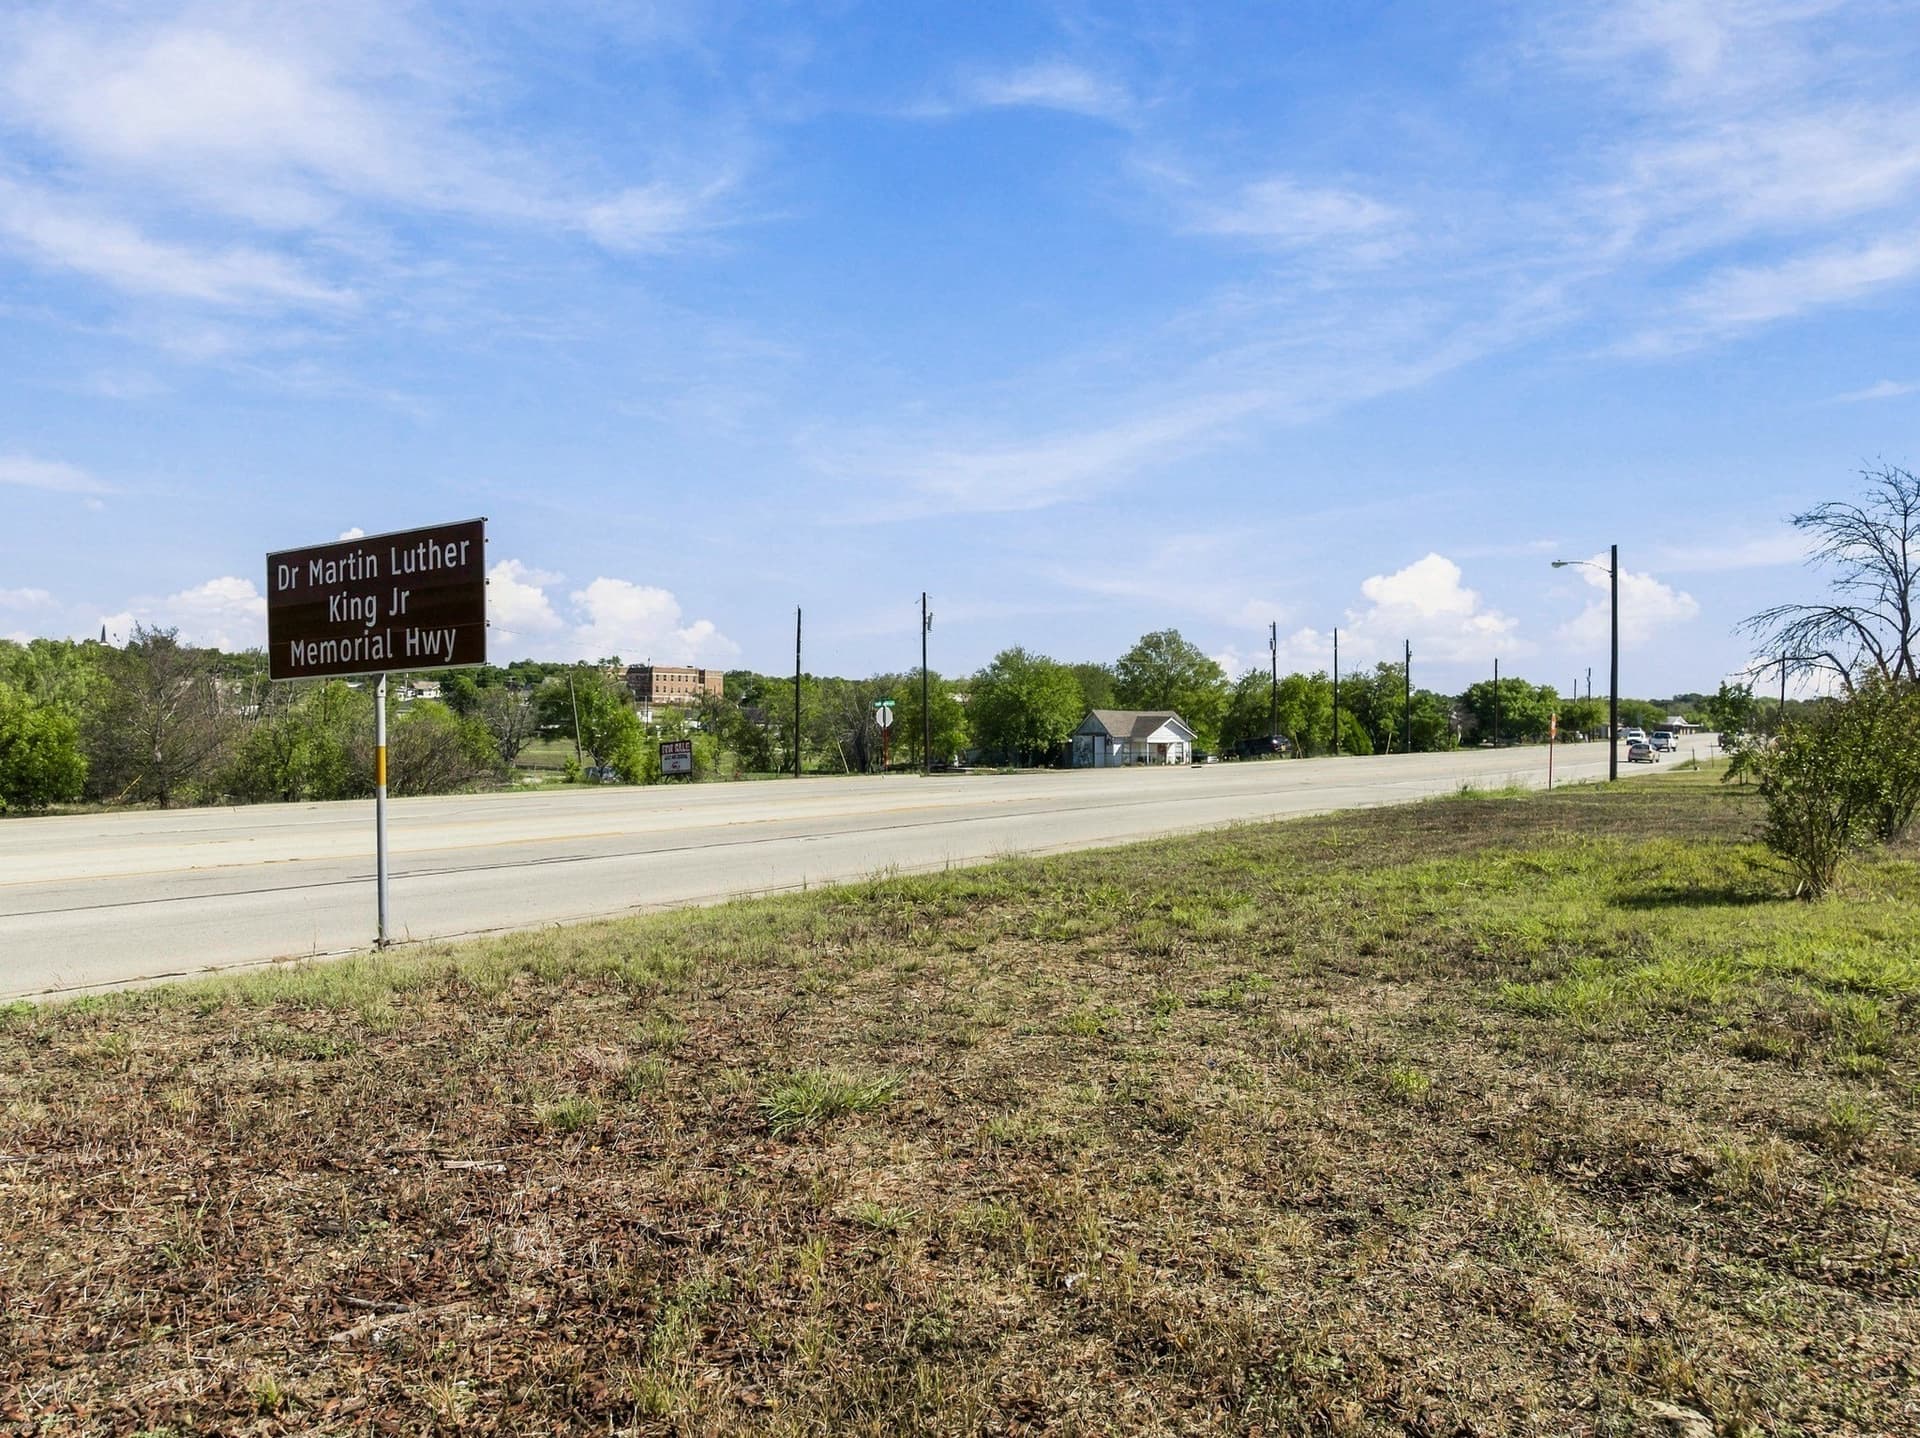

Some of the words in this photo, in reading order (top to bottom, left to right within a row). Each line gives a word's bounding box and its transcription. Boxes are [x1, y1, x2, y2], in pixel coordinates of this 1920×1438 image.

[278, 564, 299, 591] Dr
[309, 549, 378, 586] Martin
[391, 539, 470, 576] Luther
[329, 591, 377, 627] King
[389, 587, 410, 617] Jr
[290, 628, 393, 667] Memorial
[406, 627, 456, 662] Hwy
